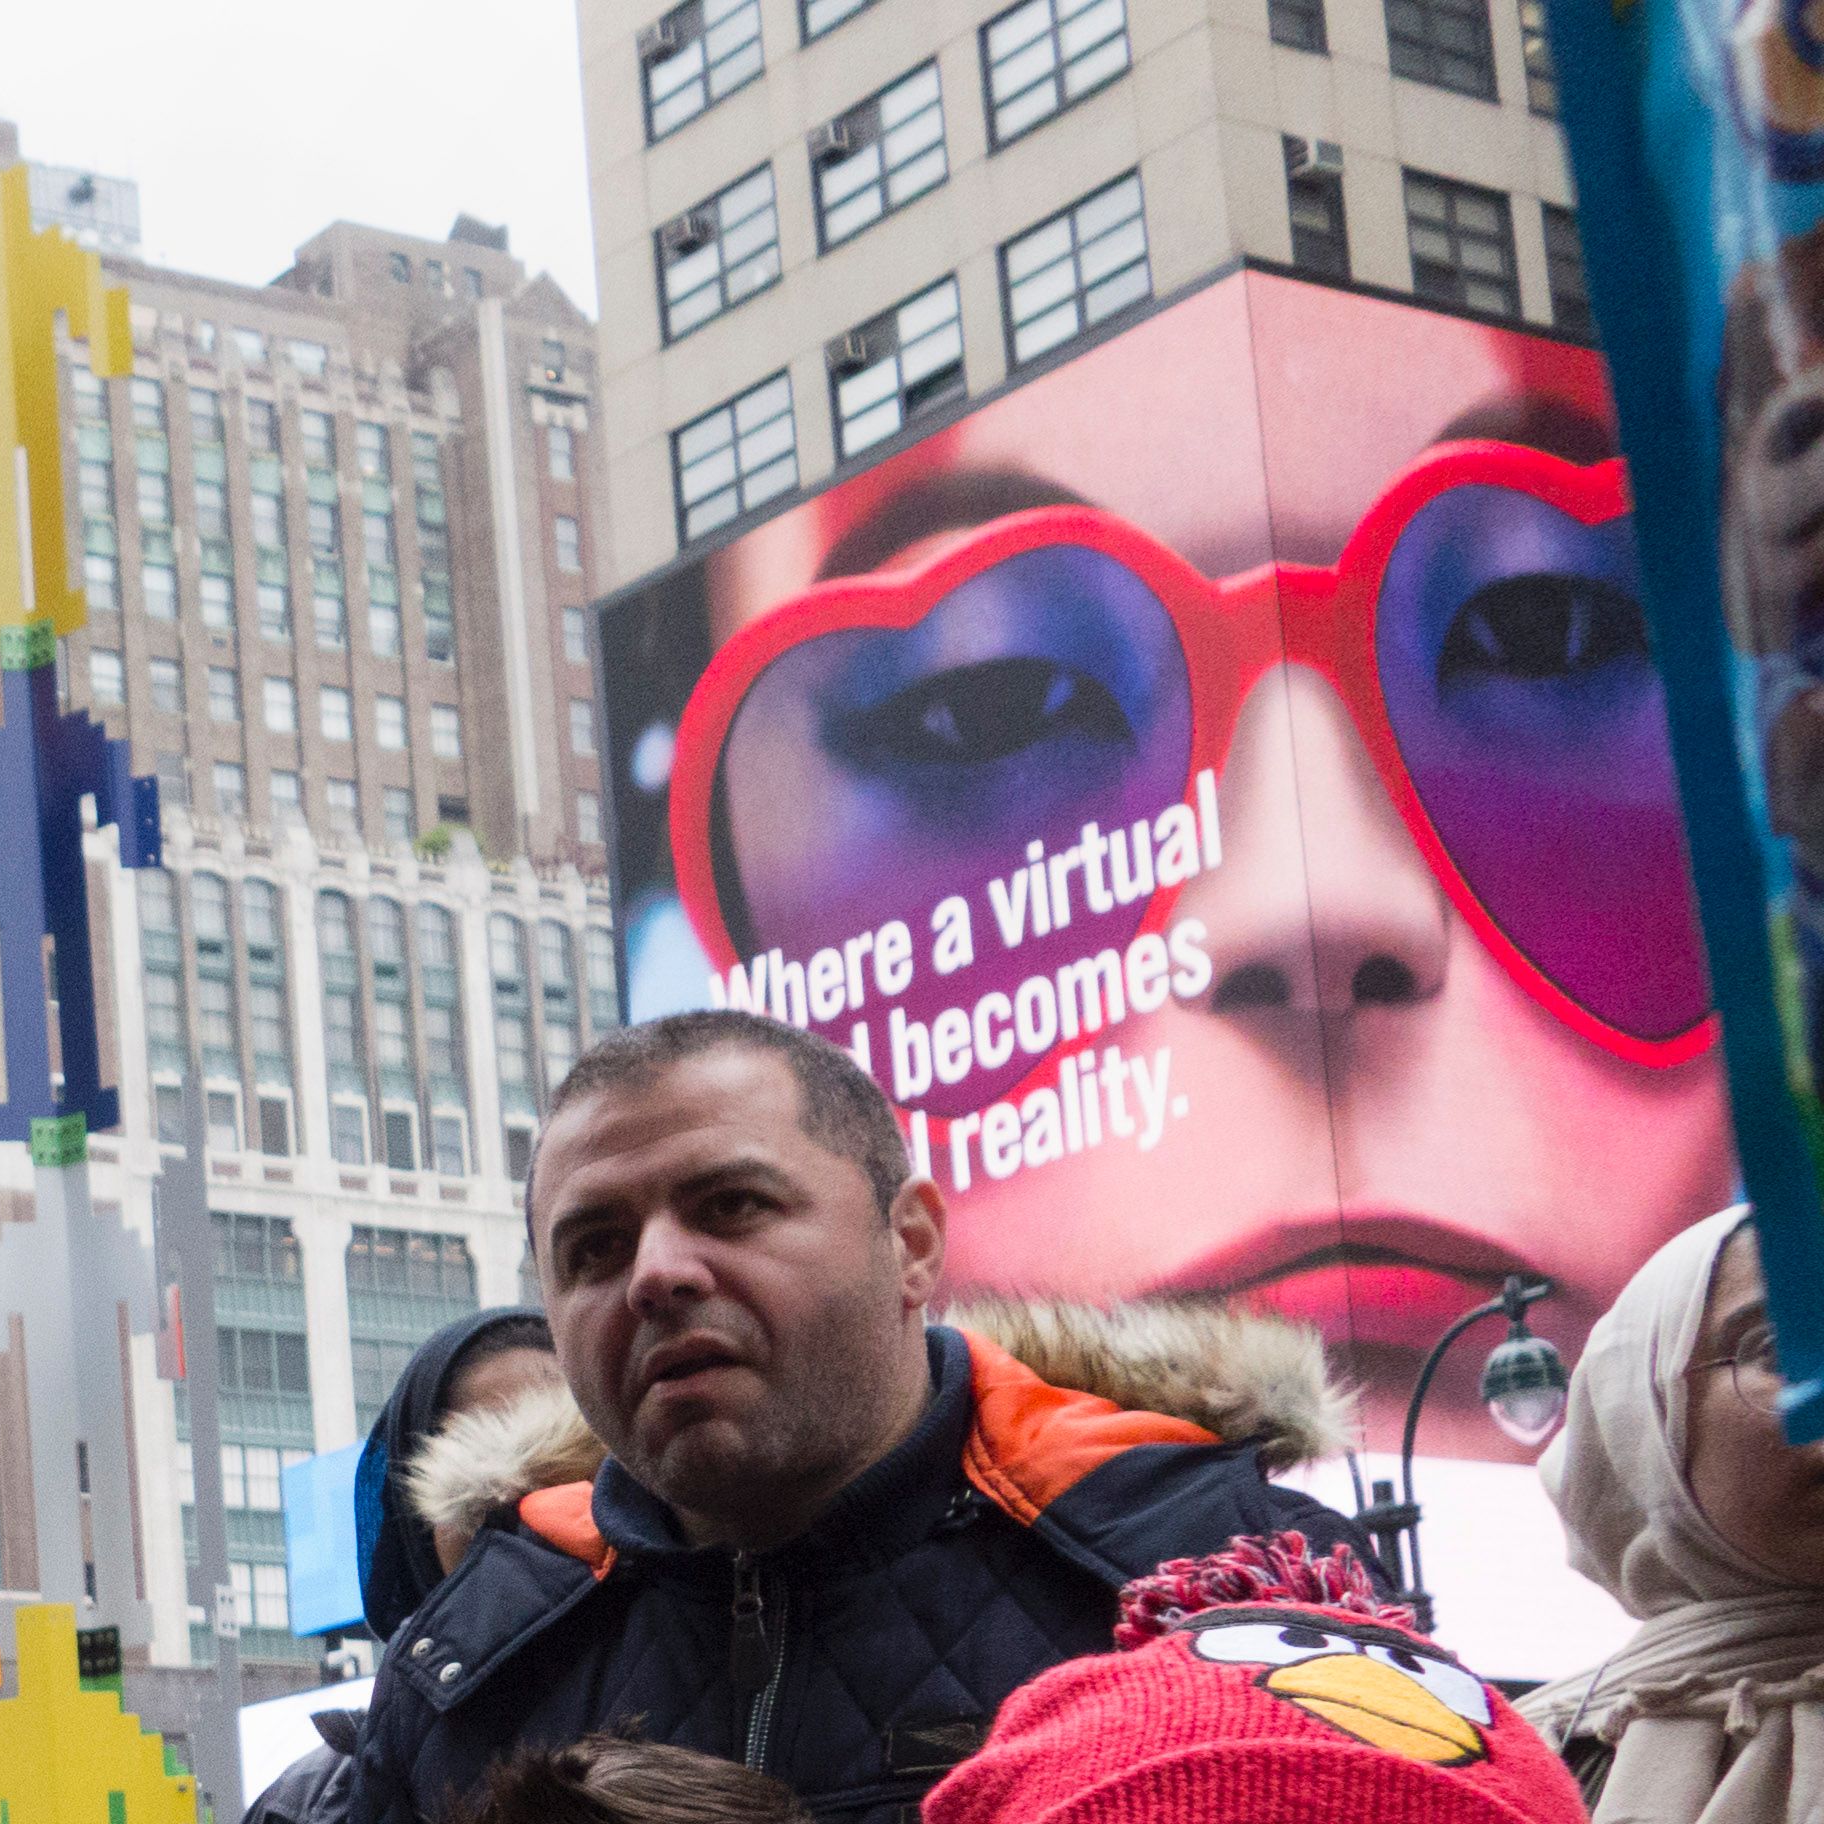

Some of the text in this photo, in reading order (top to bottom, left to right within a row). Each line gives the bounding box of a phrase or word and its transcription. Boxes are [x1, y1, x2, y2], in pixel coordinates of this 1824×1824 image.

[707, 767, 1223, 1029] Where a virtual
[888, 916, 1214, 1103] becomes
[949, 1044, 1191, 1193] reality.
